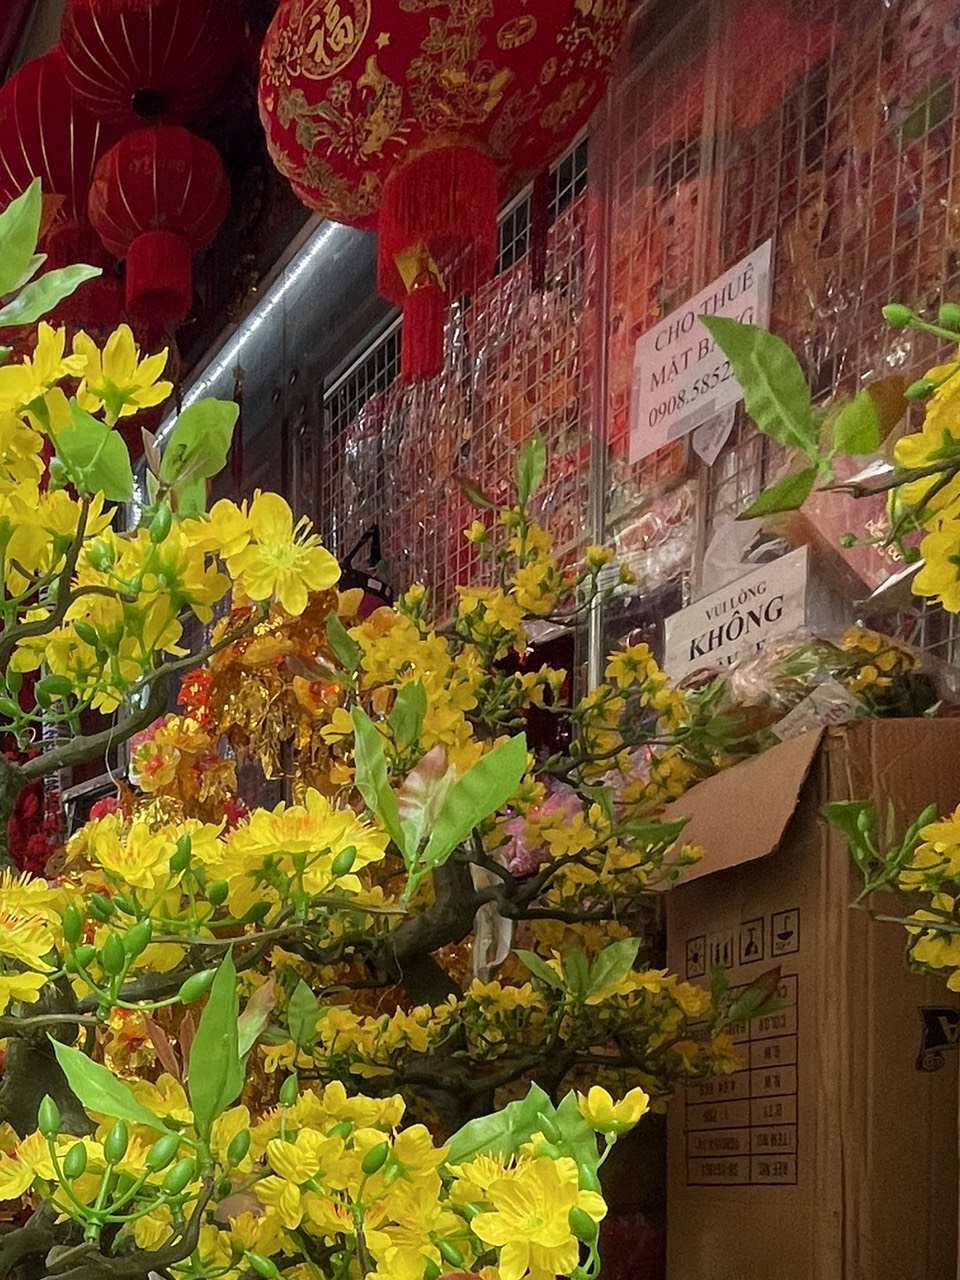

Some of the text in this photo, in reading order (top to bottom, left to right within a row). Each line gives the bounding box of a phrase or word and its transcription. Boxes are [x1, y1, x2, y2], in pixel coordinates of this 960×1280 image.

[655, 262, 754, 351] CHO THUÊ
[648, 360, 735, 428] 0908.5852
[650, 347, 692, 392] MẶT
[689, 594, 784, 661] KHÔNG
[705, 581, 767, 621] VUI LÒNG
